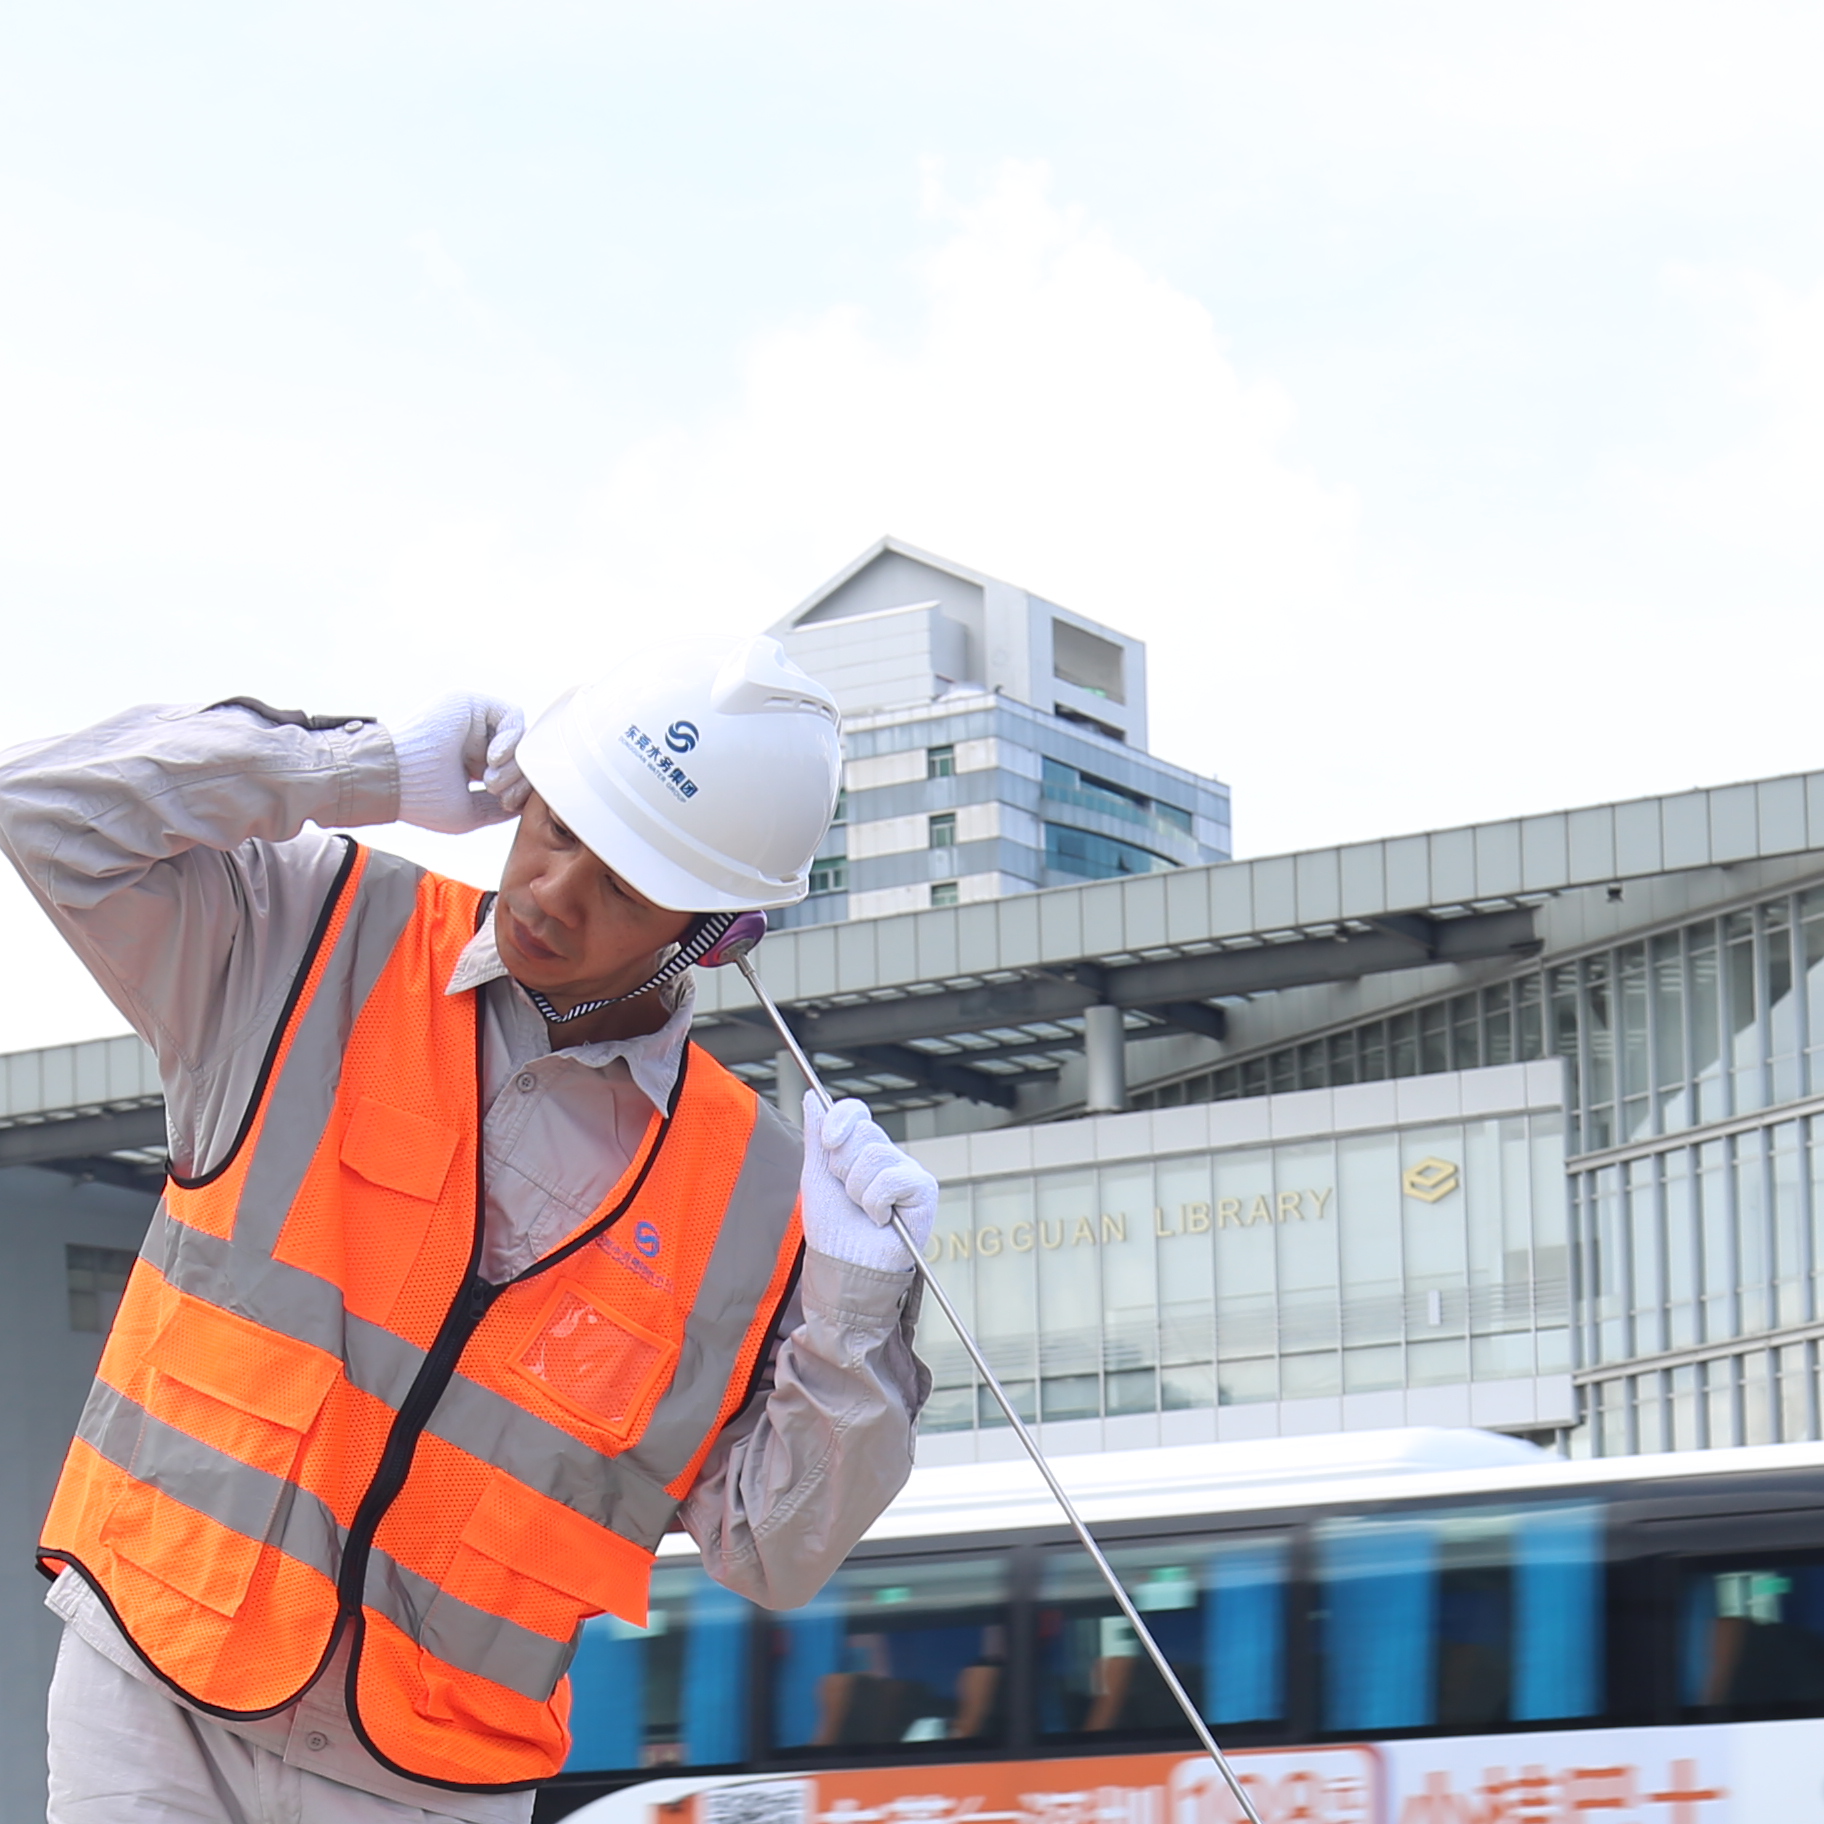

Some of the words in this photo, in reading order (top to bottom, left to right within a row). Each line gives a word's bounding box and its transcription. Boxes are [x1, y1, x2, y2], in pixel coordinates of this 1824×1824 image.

[624, 723, 699, 799] 东莞水务集团
[921, 1212, 1125, 1264] ONGGUAN
[1155, 1188, 1332, 1238] LIBRARY
